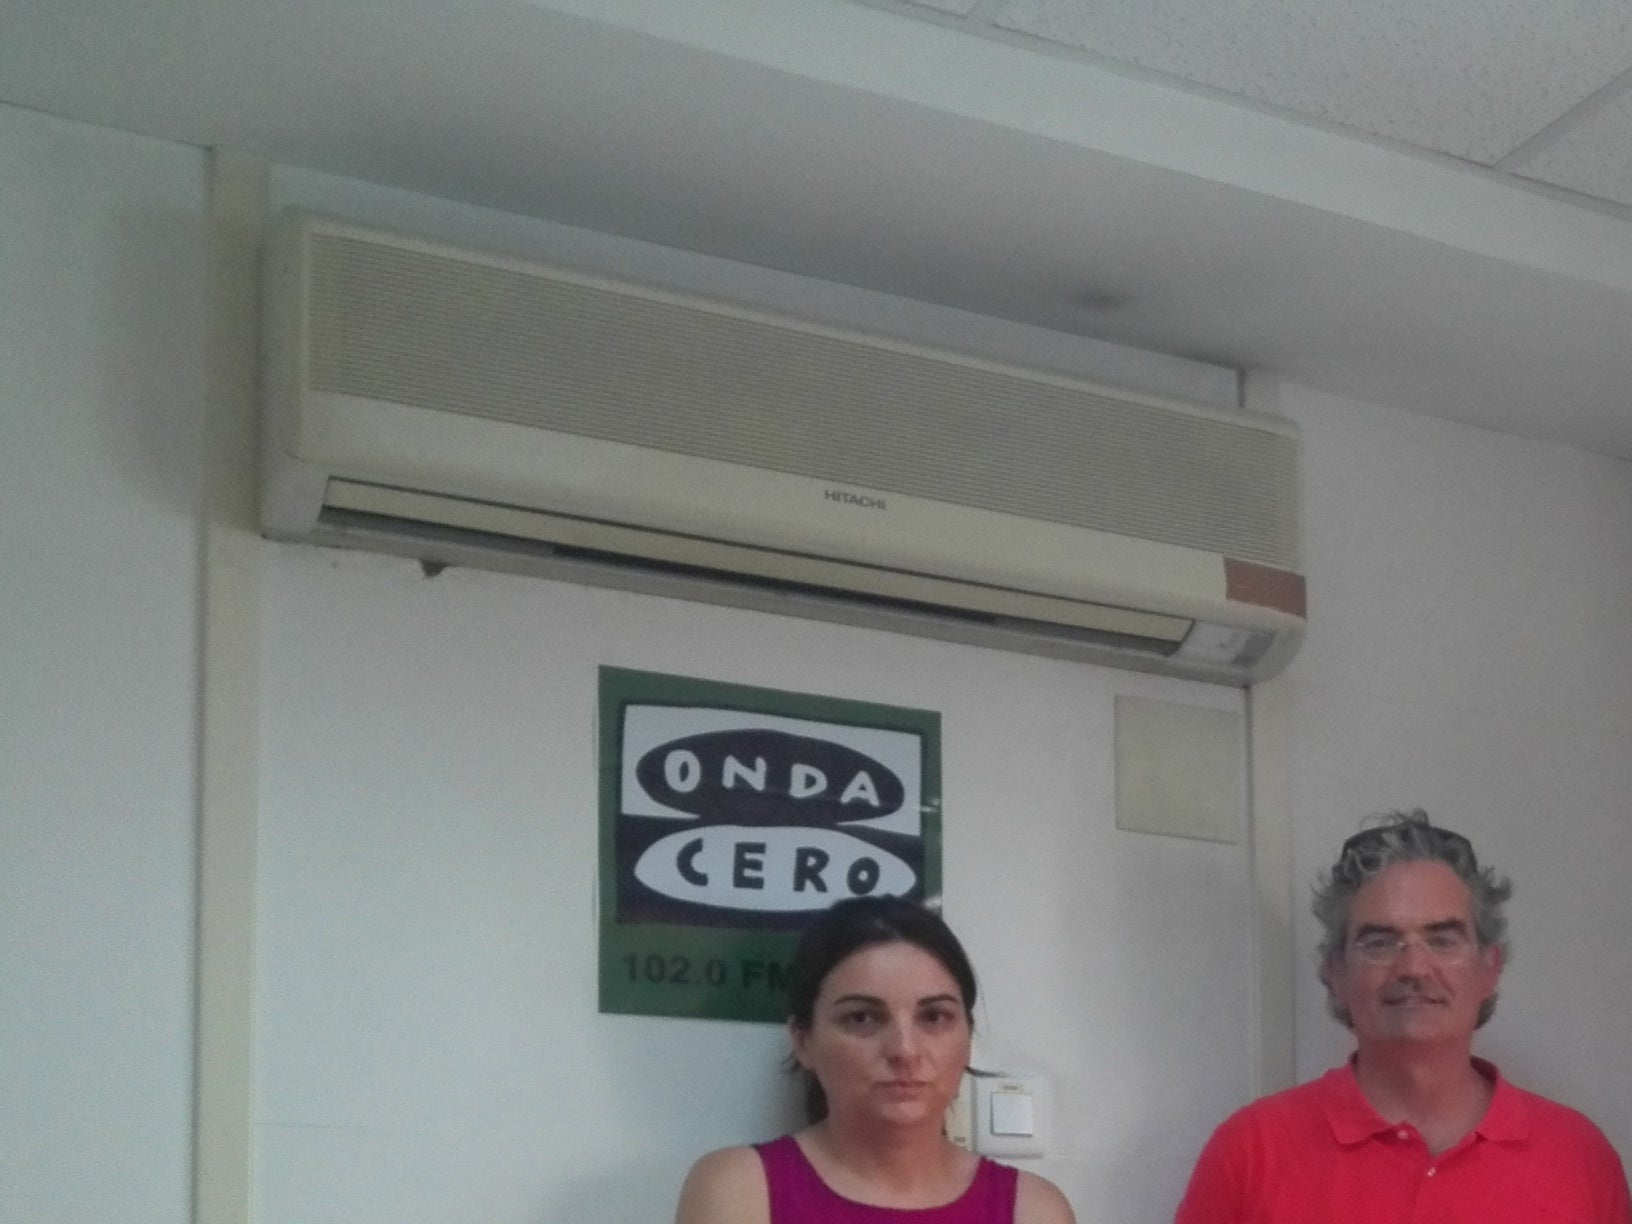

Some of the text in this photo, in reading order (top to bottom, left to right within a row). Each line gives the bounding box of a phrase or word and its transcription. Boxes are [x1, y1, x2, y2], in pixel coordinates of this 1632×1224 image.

[663, 748, 881, 808] ONDA
[675, 837, 881, 896] CERO
[623, 953, 729, 987] 102.0
